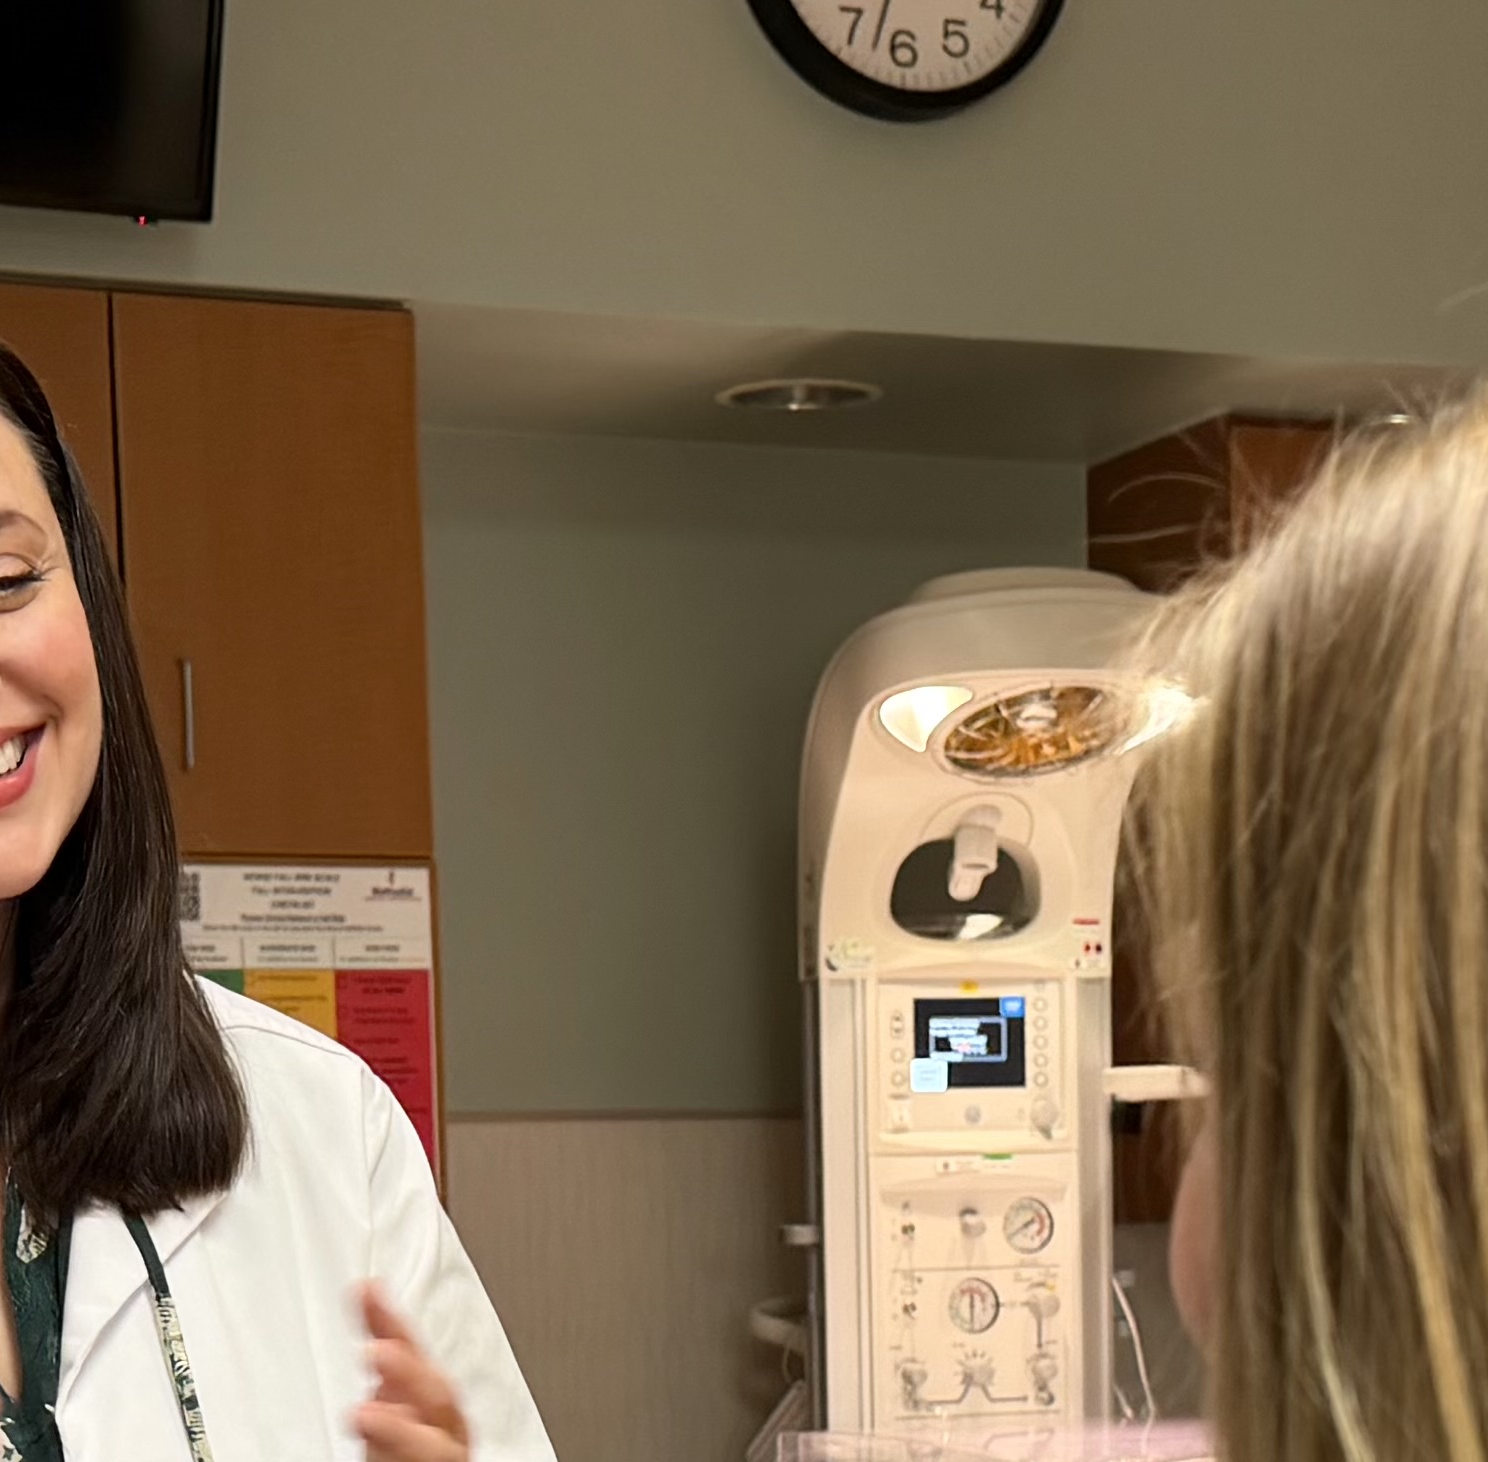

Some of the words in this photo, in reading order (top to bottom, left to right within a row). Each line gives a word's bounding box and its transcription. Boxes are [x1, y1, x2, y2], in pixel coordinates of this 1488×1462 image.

[839, 6, 863, 46] 7
[942, 18, 970, 59] 5
[889, 29, 919, 68] 6
